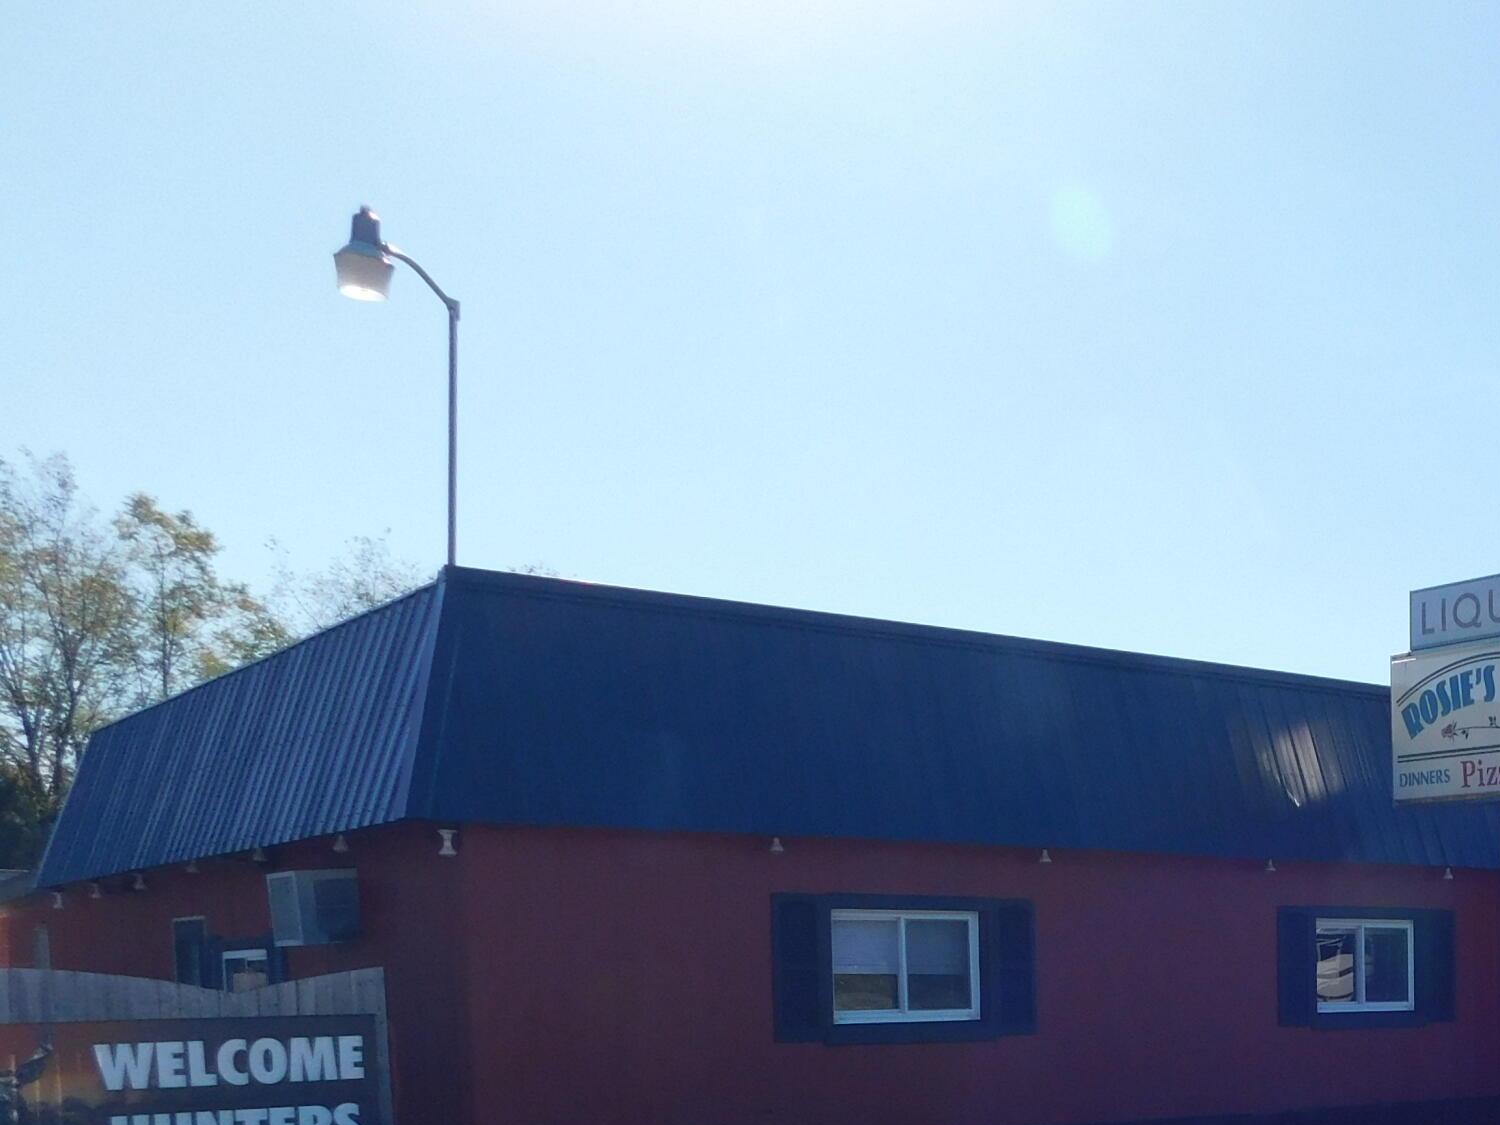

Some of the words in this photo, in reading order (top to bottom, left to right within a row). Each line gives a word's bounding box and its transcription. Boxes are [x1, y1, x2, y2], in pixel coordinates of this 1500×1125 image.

[1401, 665, 1496, 740] ROSIE'S
[1399, 768, 1450, 788] DINNERS
[94, 1034, 365, 1091] WELCOME
